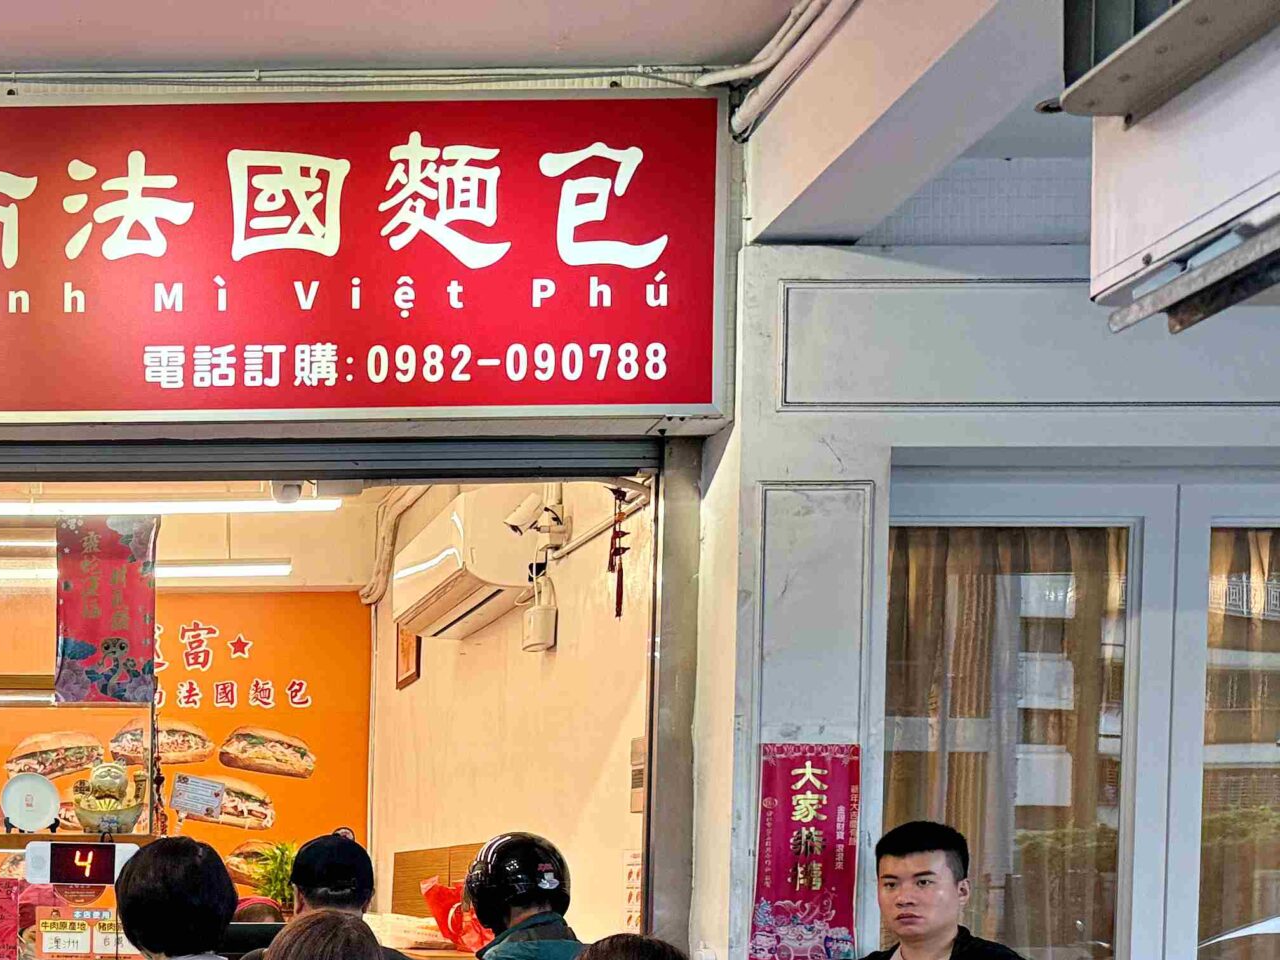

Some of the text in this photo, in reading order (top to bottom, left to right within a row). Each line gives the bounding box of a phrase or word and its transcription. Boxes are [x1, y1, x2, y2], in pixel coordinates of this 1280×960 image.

[153, 275, 227, 312] Mì
[293, 276, 463, 318] Việt
[531, 270, 669, 308] Phú
[74, 850, 94, 878] 4
[41, 921, 87, 932] 牛肉原產地
